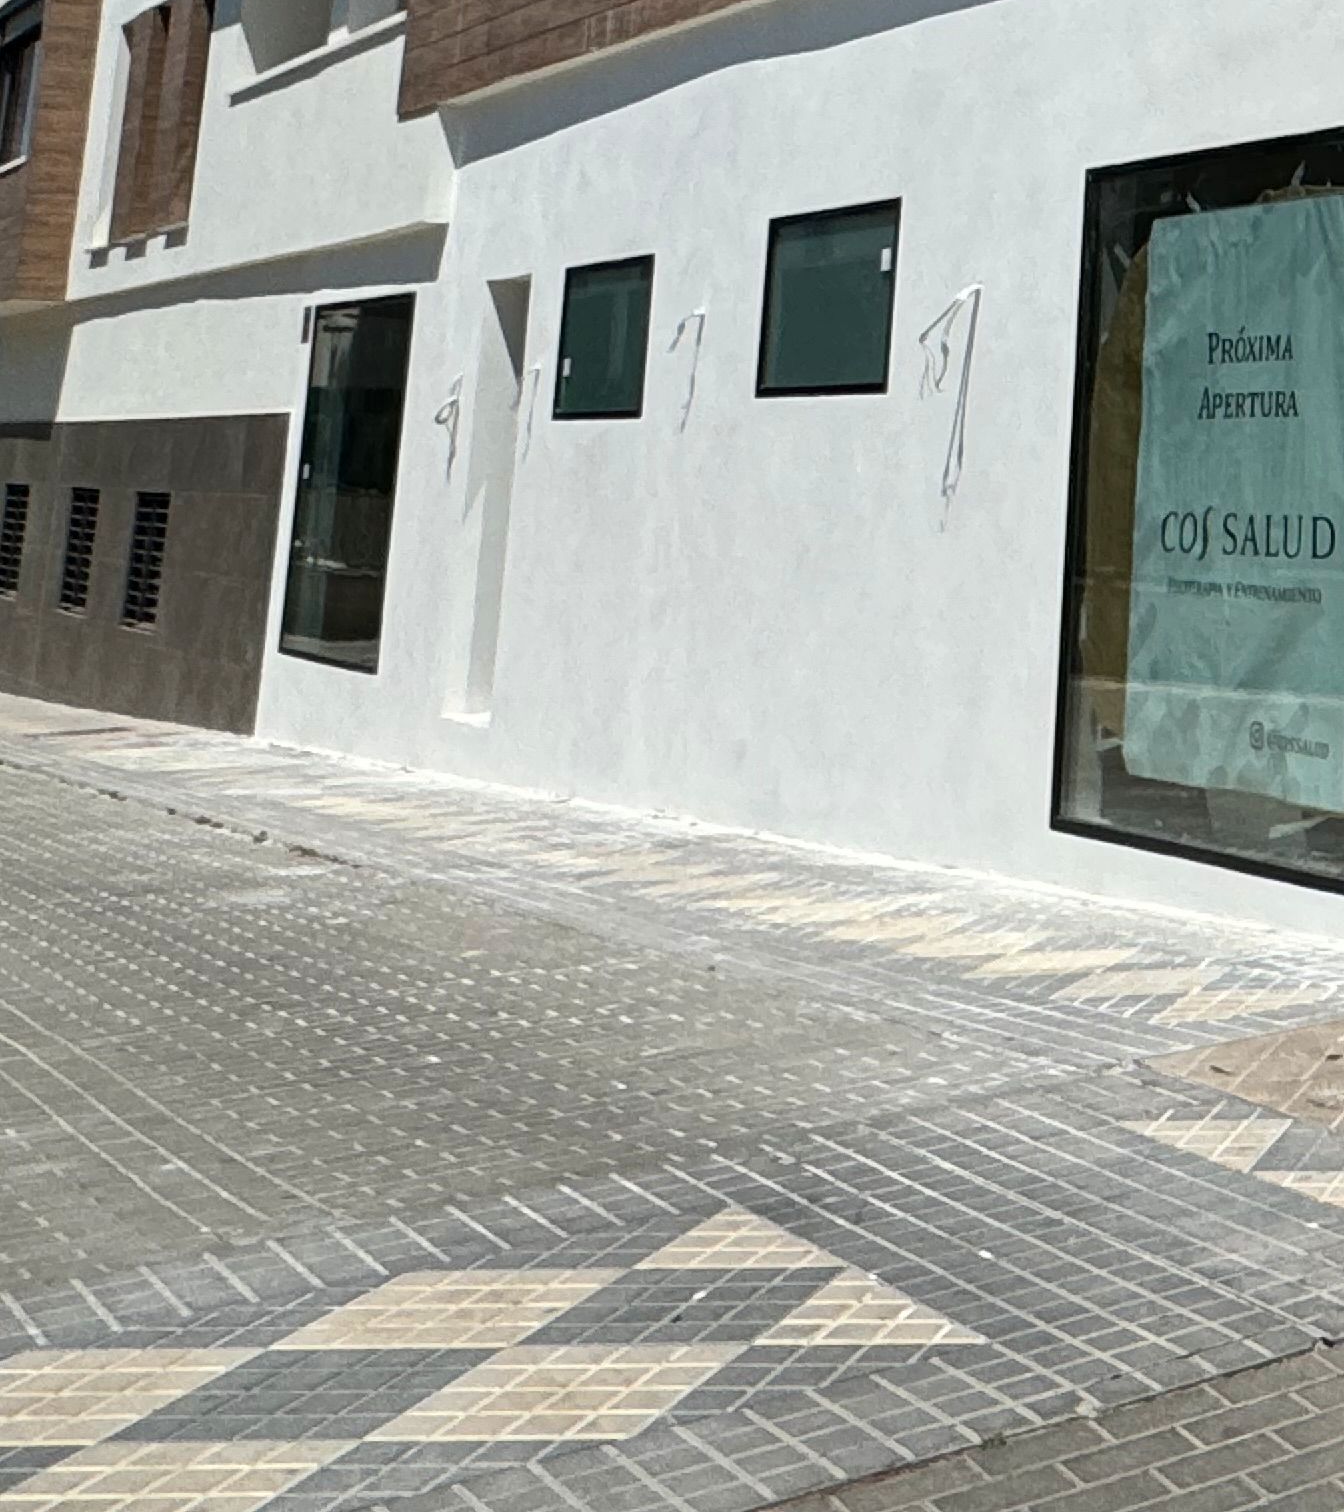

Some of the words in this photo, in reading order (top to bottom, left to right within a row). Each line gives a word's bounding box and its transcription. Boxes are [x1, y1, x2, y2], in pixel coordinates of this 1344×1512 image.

[1207, 325, 1294, 365] PRÓXIMA
[1198, 386, 1299, 420] APERTURA
[1222, 512, 1336, 559] SALUD
